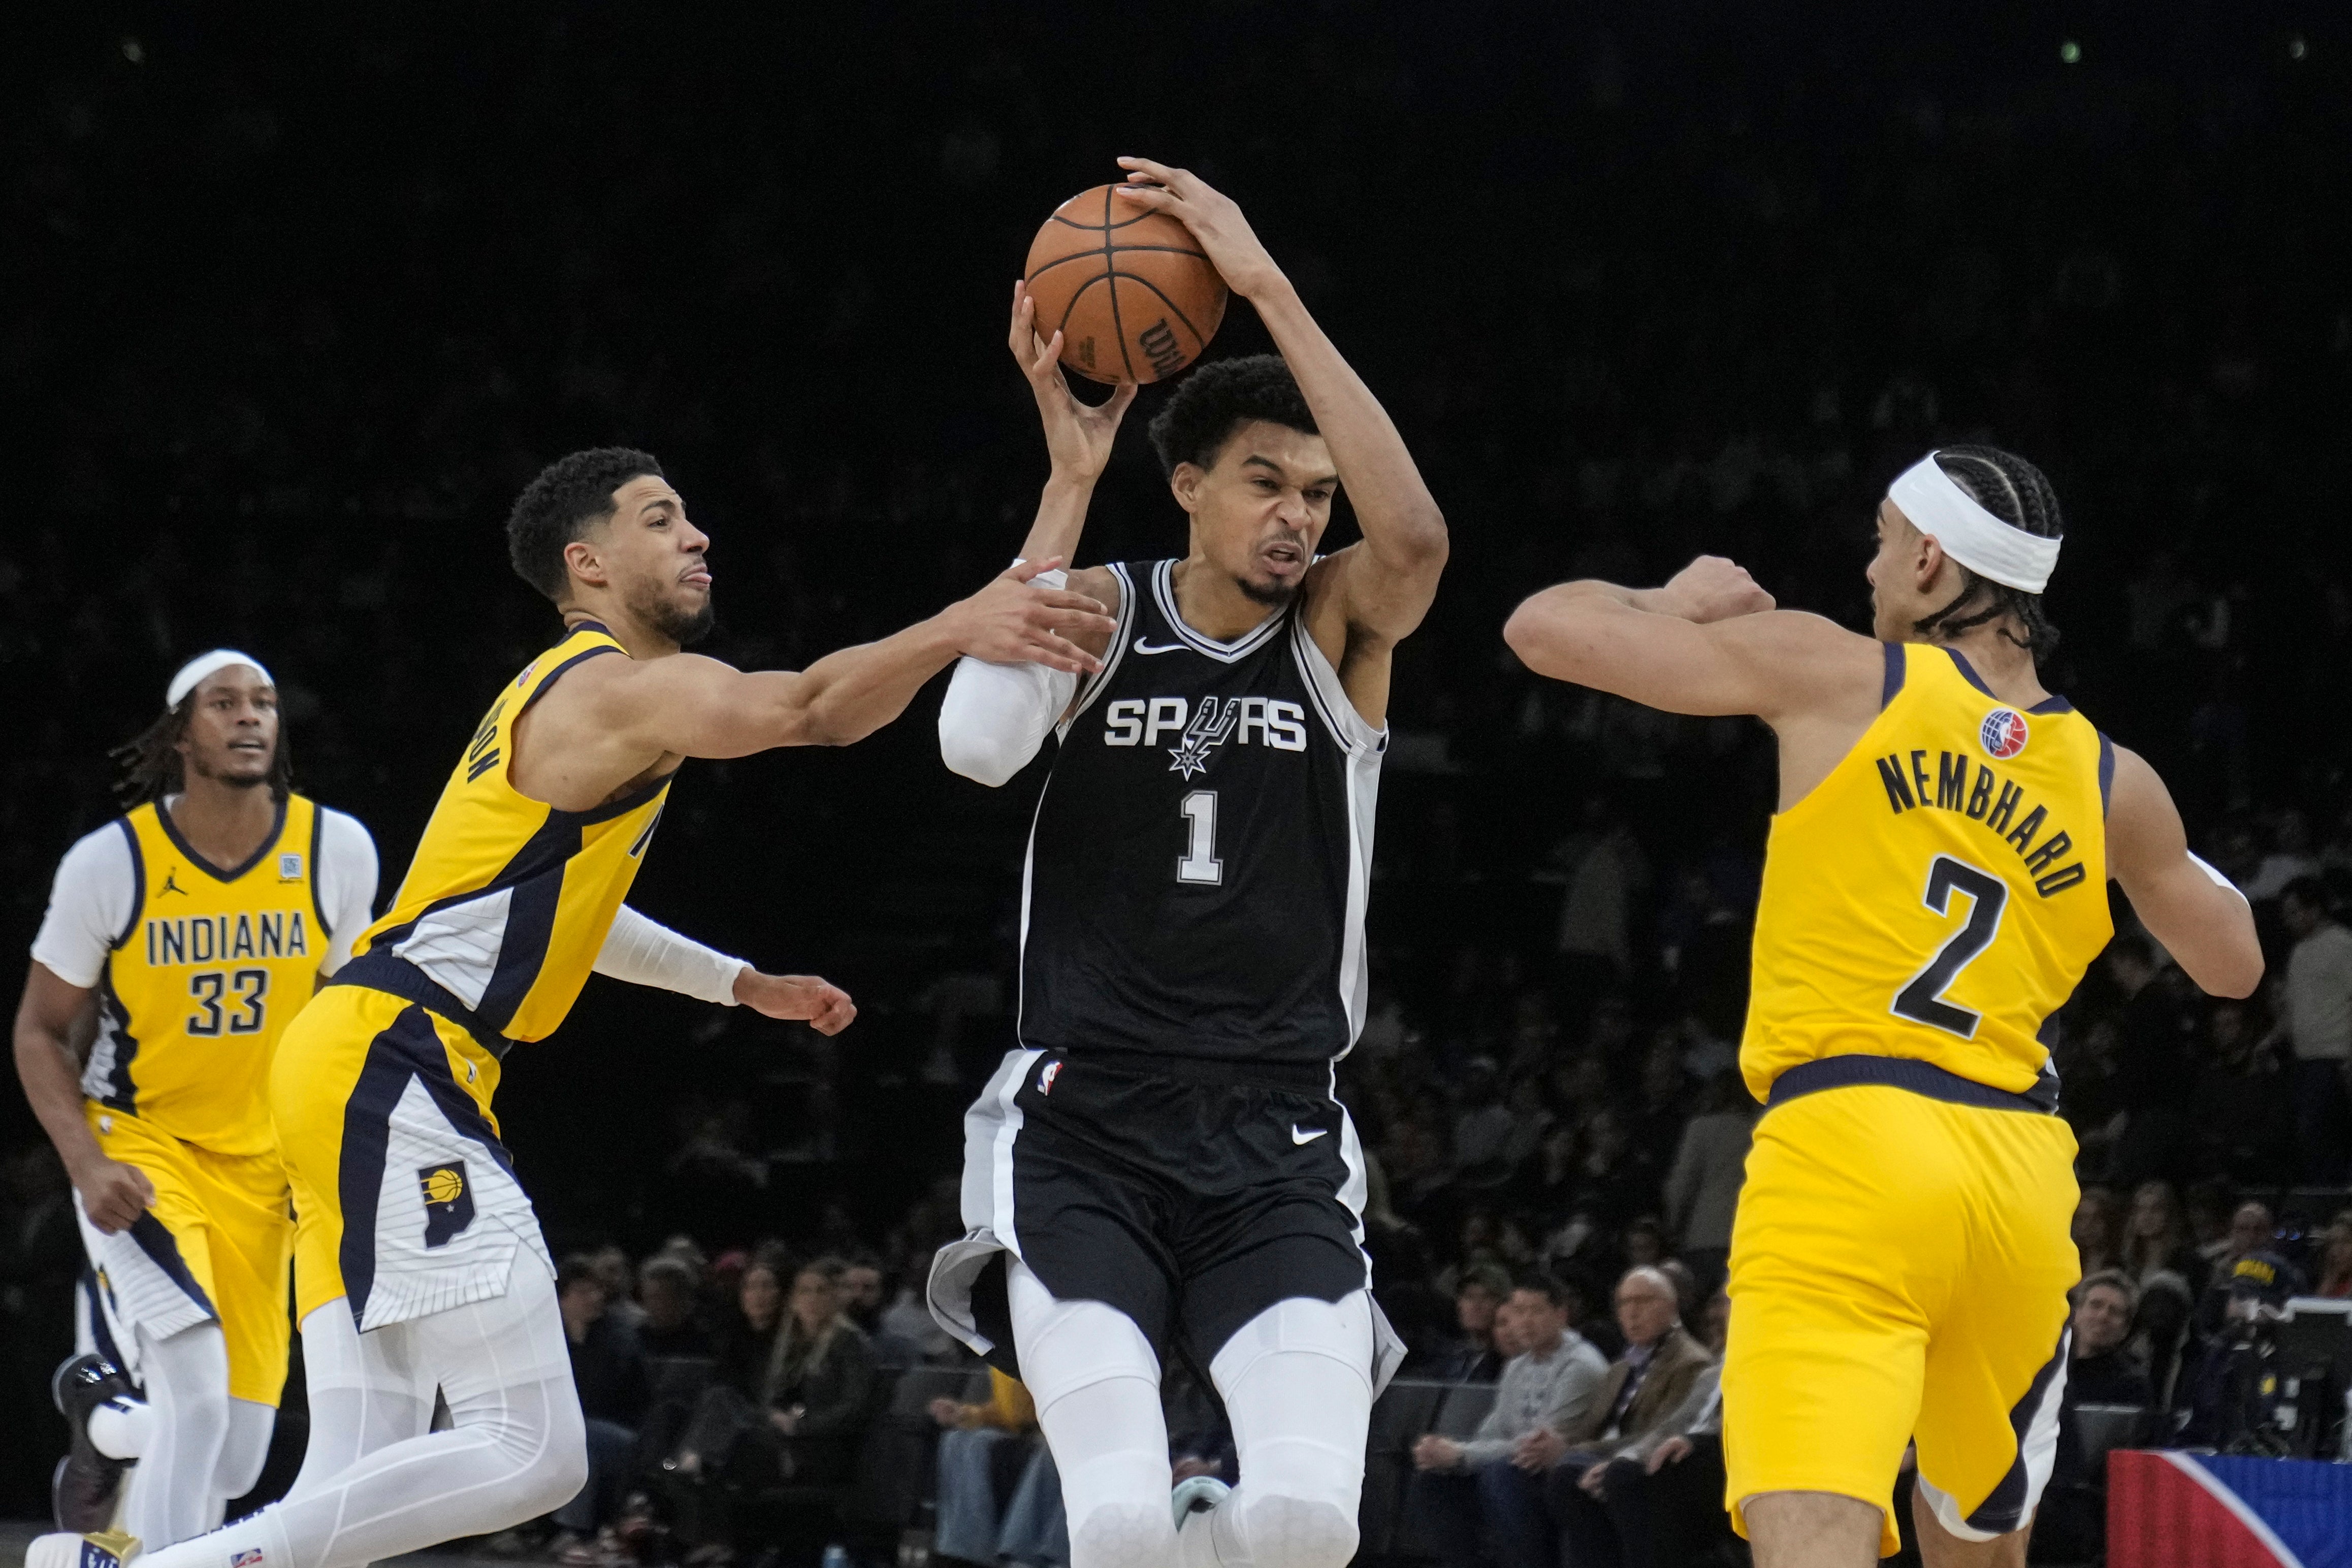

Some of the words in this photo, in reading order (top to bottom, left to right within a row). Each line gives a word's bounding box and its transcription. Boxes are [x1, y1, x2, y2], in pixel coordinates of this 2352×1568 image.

[1104, 695, 1307, 782] SPURS
[1177, 790, 1224, 886] 1
[1876, 749, 2086, 899] NEMBHARD
[148, 910, 308, 966] INDIANA
[1889, 853, 2009, 1041] 2
[186, 967, 269, 1037] 33
